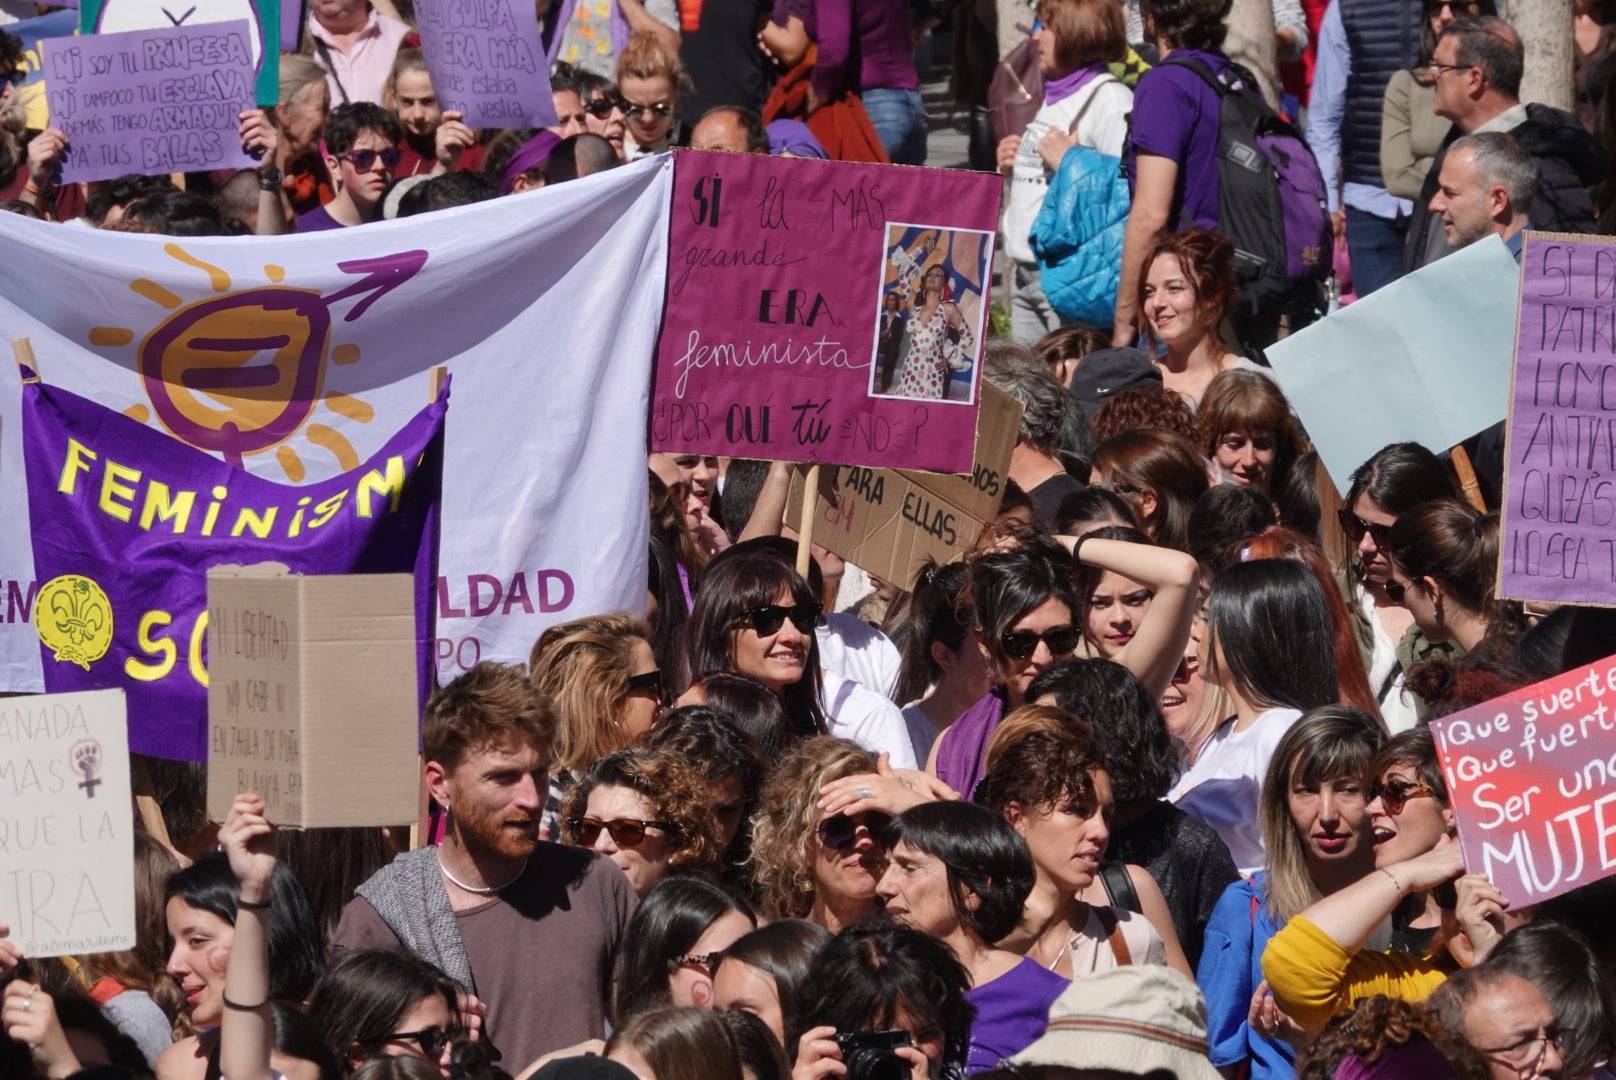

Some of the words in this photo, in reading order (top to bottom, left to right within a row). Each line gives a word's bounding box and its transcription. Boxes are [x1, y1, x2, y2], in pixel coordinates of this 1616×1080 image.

[448, 0, 518, 32] CULPA
[88, 53, 114, 76] SOY
[440, 31, 483, 71] ERA
[488, 33, 537, 74] MÍA
[82, 89, 133, 109] TAMPOCO
[110, 115, 148, 131] TENGO
[151, 102, 251, 133] ARMADUR
[99, 143, 132, 166] TUS
[141, 131, 224, 170] BALAS
[760, 176, 789, 231] la
[672, 238, 808, 297] grande
[759, 289, 836, 327] ERA
[674, 330, 872, 399] feminista
[726, 392, 776, 444] QUÉ
[901, 492, 956, 546] ELLAS
[1520, 700, 1616, 762] fuert
[78, 811, 114, 842] LA
[1472, 782, 1541, 830] Ser
